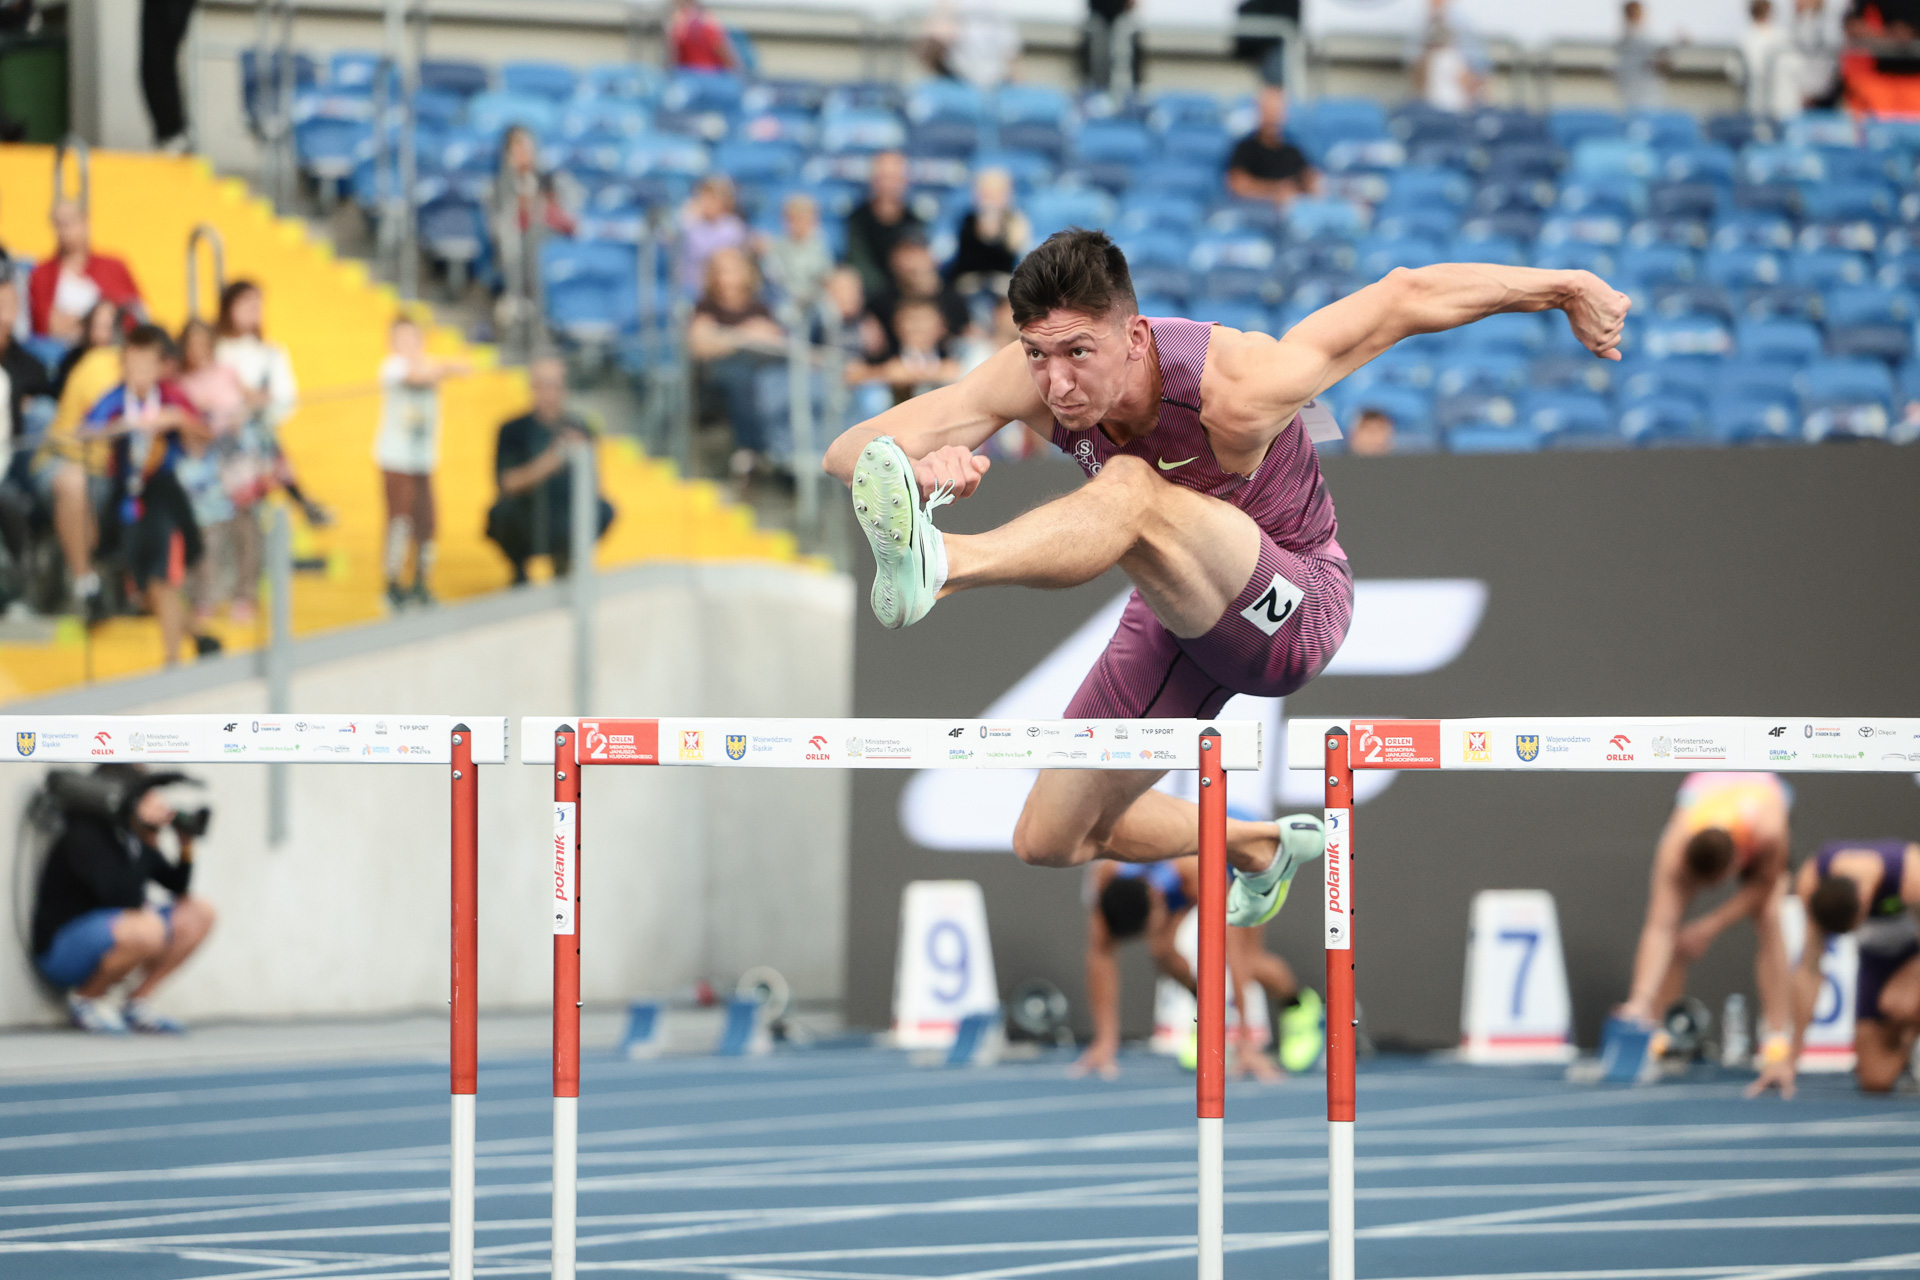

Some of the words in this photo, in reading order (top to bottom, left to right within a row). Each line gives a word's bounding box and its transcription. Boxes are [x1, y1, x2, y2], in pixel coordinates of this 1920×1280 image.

[1080, 442, 1090, 454] S
[1252, 586, 1292, 623] 2
[223, 723, 238, 732] 4F
[1768, 726, 1787, 738] 4F
[948, 728, 965, 738] 4F
[147, 740, 163, 748] Sportu
[167, 740, 190, 748] Turystyki
[752, 736, 792, 744] Województwo
[865, 738, 900, 746] Ministerstwo
[1545, 735, 1591, 744] Województwo
[1673, 737, 1713, 745] Ministerstwo
[752, 743, 773, 752] Śląskie
[1545, 743, 1569, 753] Śląskie
[1673, 745, 1693, 754] Sportu
[1698, 745, 1727, 753] Turystyki
[554, 833, 568, 901] polanik
[1326, 841, 1344, 914] polanik
[926, 919, 970, 1004] 9
[1495, 931, 1540, 1020] 7
